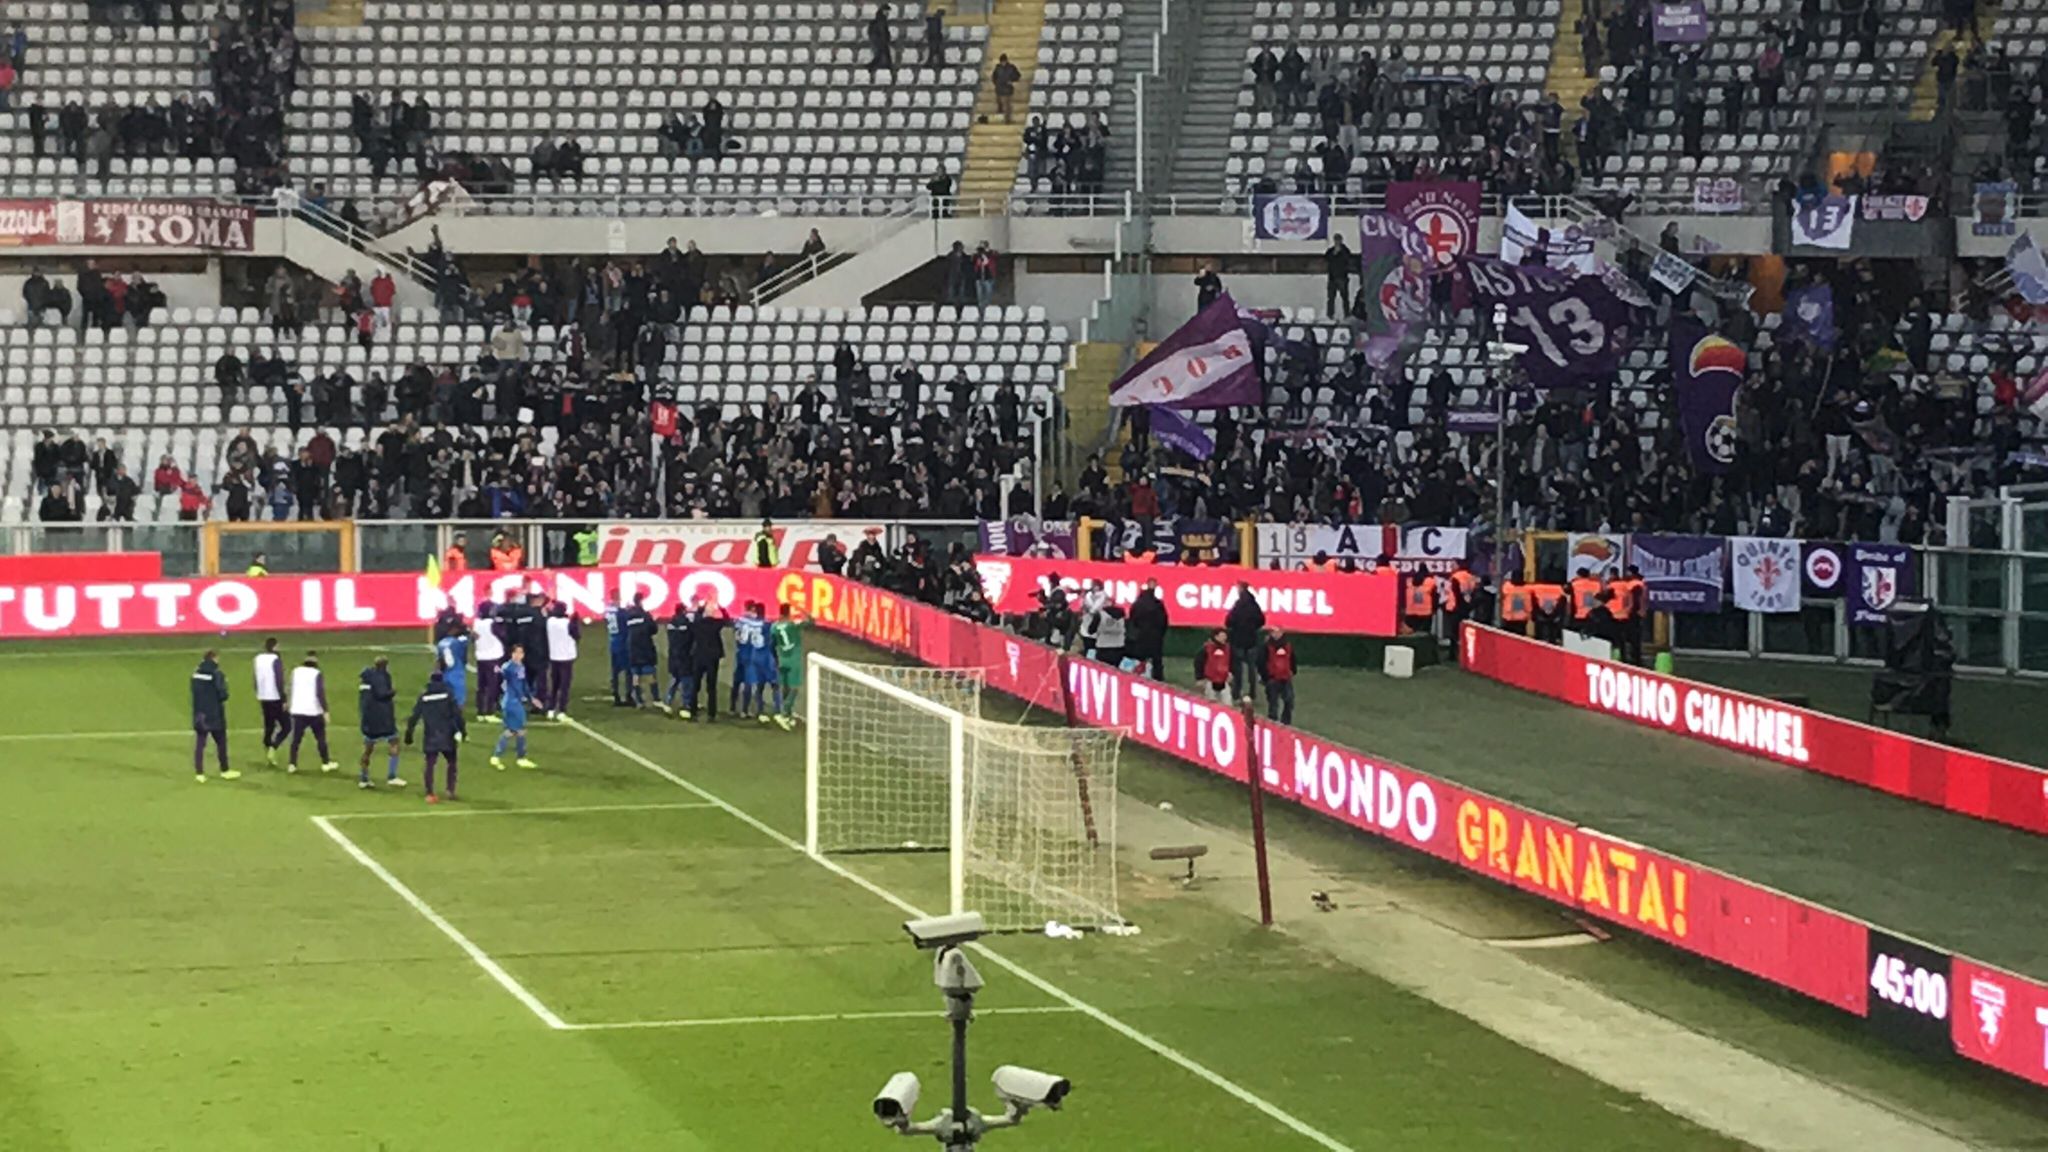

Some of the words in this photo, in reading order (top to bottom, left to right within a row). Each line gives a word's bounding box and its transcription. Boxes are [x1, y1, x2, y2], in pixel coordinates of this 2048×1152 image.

[124, 215, 248, 248] ROMA
[1510, 297, 1604, 367] 13
[600, 526, 884, 570] inalp
[303, 578, 376, 623] IL
[1586, 663, 1677, 726] TORINO
[1684, 689, 1809, 761] CHANNEL
[1131, 682, 1236, 767] TUTTO
[1253, 724, 1279, 786] L
[1294, 738, 1437, 842] MONDO
[1457, 798, 1687, 938] GRANATA!
[1870, 953, 1948, 1020] 45:00
